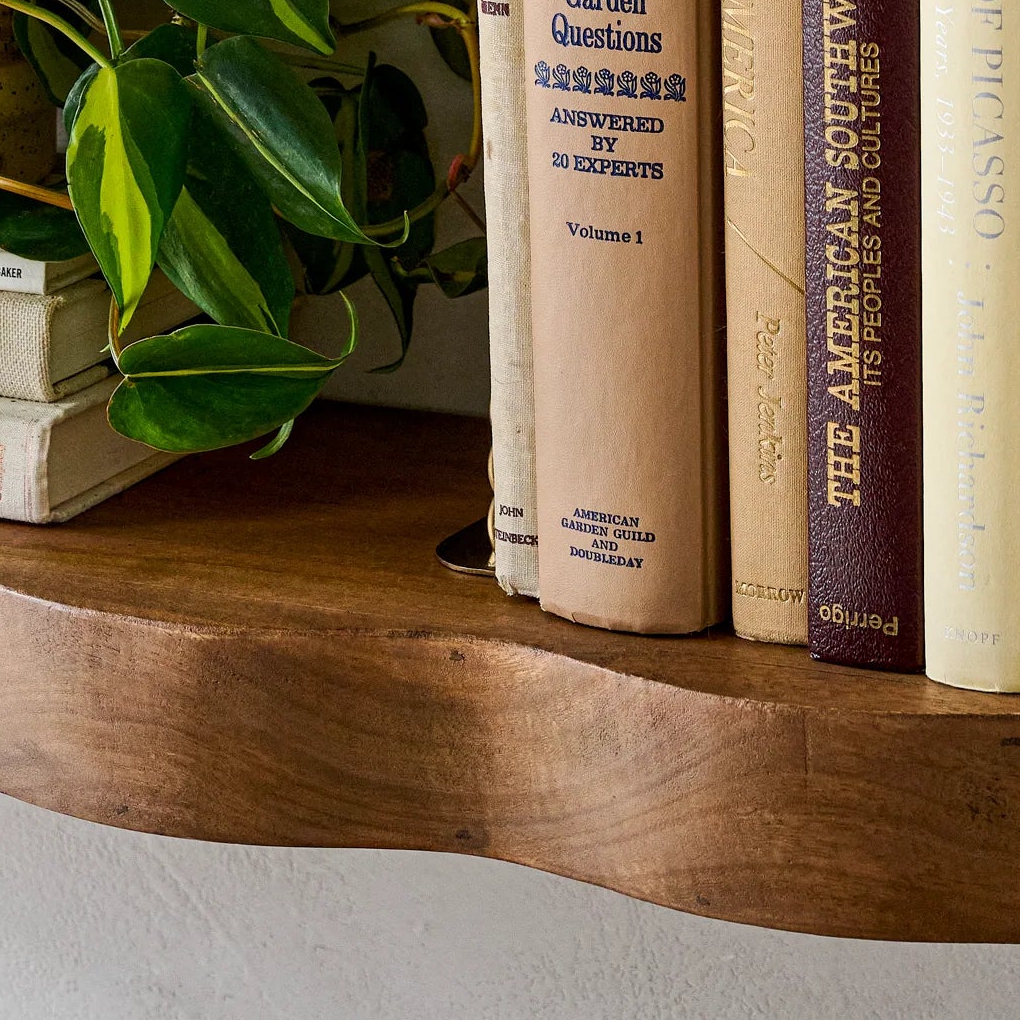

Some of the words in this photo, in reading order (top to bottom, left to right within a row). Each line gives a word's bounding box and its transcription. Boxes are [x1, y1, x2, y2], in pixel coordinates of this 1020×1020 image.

[551, 12, 663, 54] Questions
[549, 107, 665, 134] ANSWERED
[860, 42, 881, 169] CULTURES
[590, 135, 618, 153] BY
[971, 43, 1006, 240] PICASSO
[551, 151, 569, 170] 20
[573, 154, 664, 180] EXPERTS
[862, 176, 882, 224] AND
[565, 221, 632, 244] Volume
[635, 230, 643, 245] 1
[862, 233, 882, 328] PEOPLES
[825, 182, 860, 411] AMERICAN
[756, 310, 781, 380] Peter
[956, 290, 985, 378] John
[863, 349, 882, 386] ITS
[827, 421, 861, 507] THE
[956, 391, 986, 593] Richardson
[499, 504, 524, 518] JOHN
[572, 507, 640, 528] AMERICAN
[495, 528, 539, 547] TEINBECK
[560, 517, 609, 537] GARDEN
[613, 529, 656, 543] GUILD
[591, 538, 618, 552] AND
[569, 546, 644, 569] DOUBLEDAY
[735, 580, 806, 605] MORROW
[819, 603, 899, 636] Perrigo
[943, 626, 1001, 646] KNOPF
